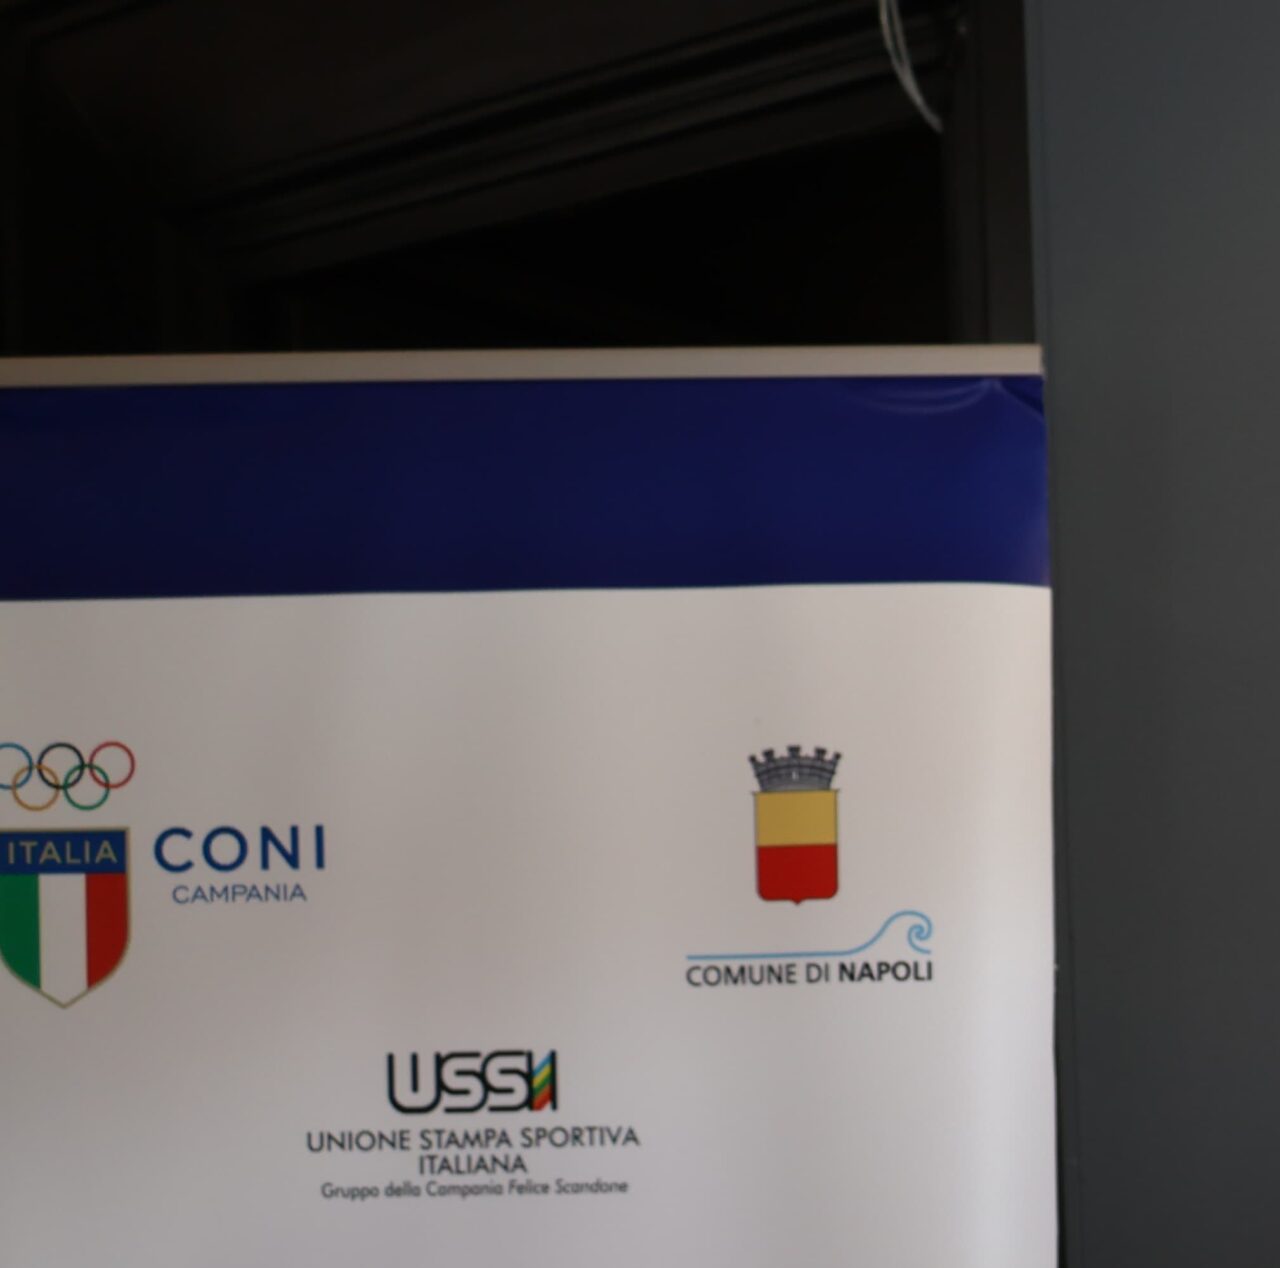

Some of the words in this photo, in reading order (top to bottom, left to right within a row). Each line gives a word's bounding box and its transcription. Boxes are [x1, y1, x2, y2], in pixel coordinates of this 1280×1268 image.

[8, 840, 118, 864] ITALIA
[154, 825, 324, 873] CONI
[172, 883, 308, 905] CAMPANIA
[686, 963, 797, 988] COMUNE
[805, 962, 830, 984] DI
[838, 960, 933, 983] NAPOLI
[307, 1130, 410, 1152] UNIONE
[419, 1128, 512, 1150] STAMPA
[520, 1126, 640, 1149] SPORTIVA
[419, 1154, 527, 1175] ITALIANA
[321, 1182, 380, 1201] Gruppo
[384, 1180, 421, 1198] della
[425, 1179, 504, 1199] Campania
[508, 1178, 550, 1196] Felice
[555, 1177, 629, 1195] Scandone
